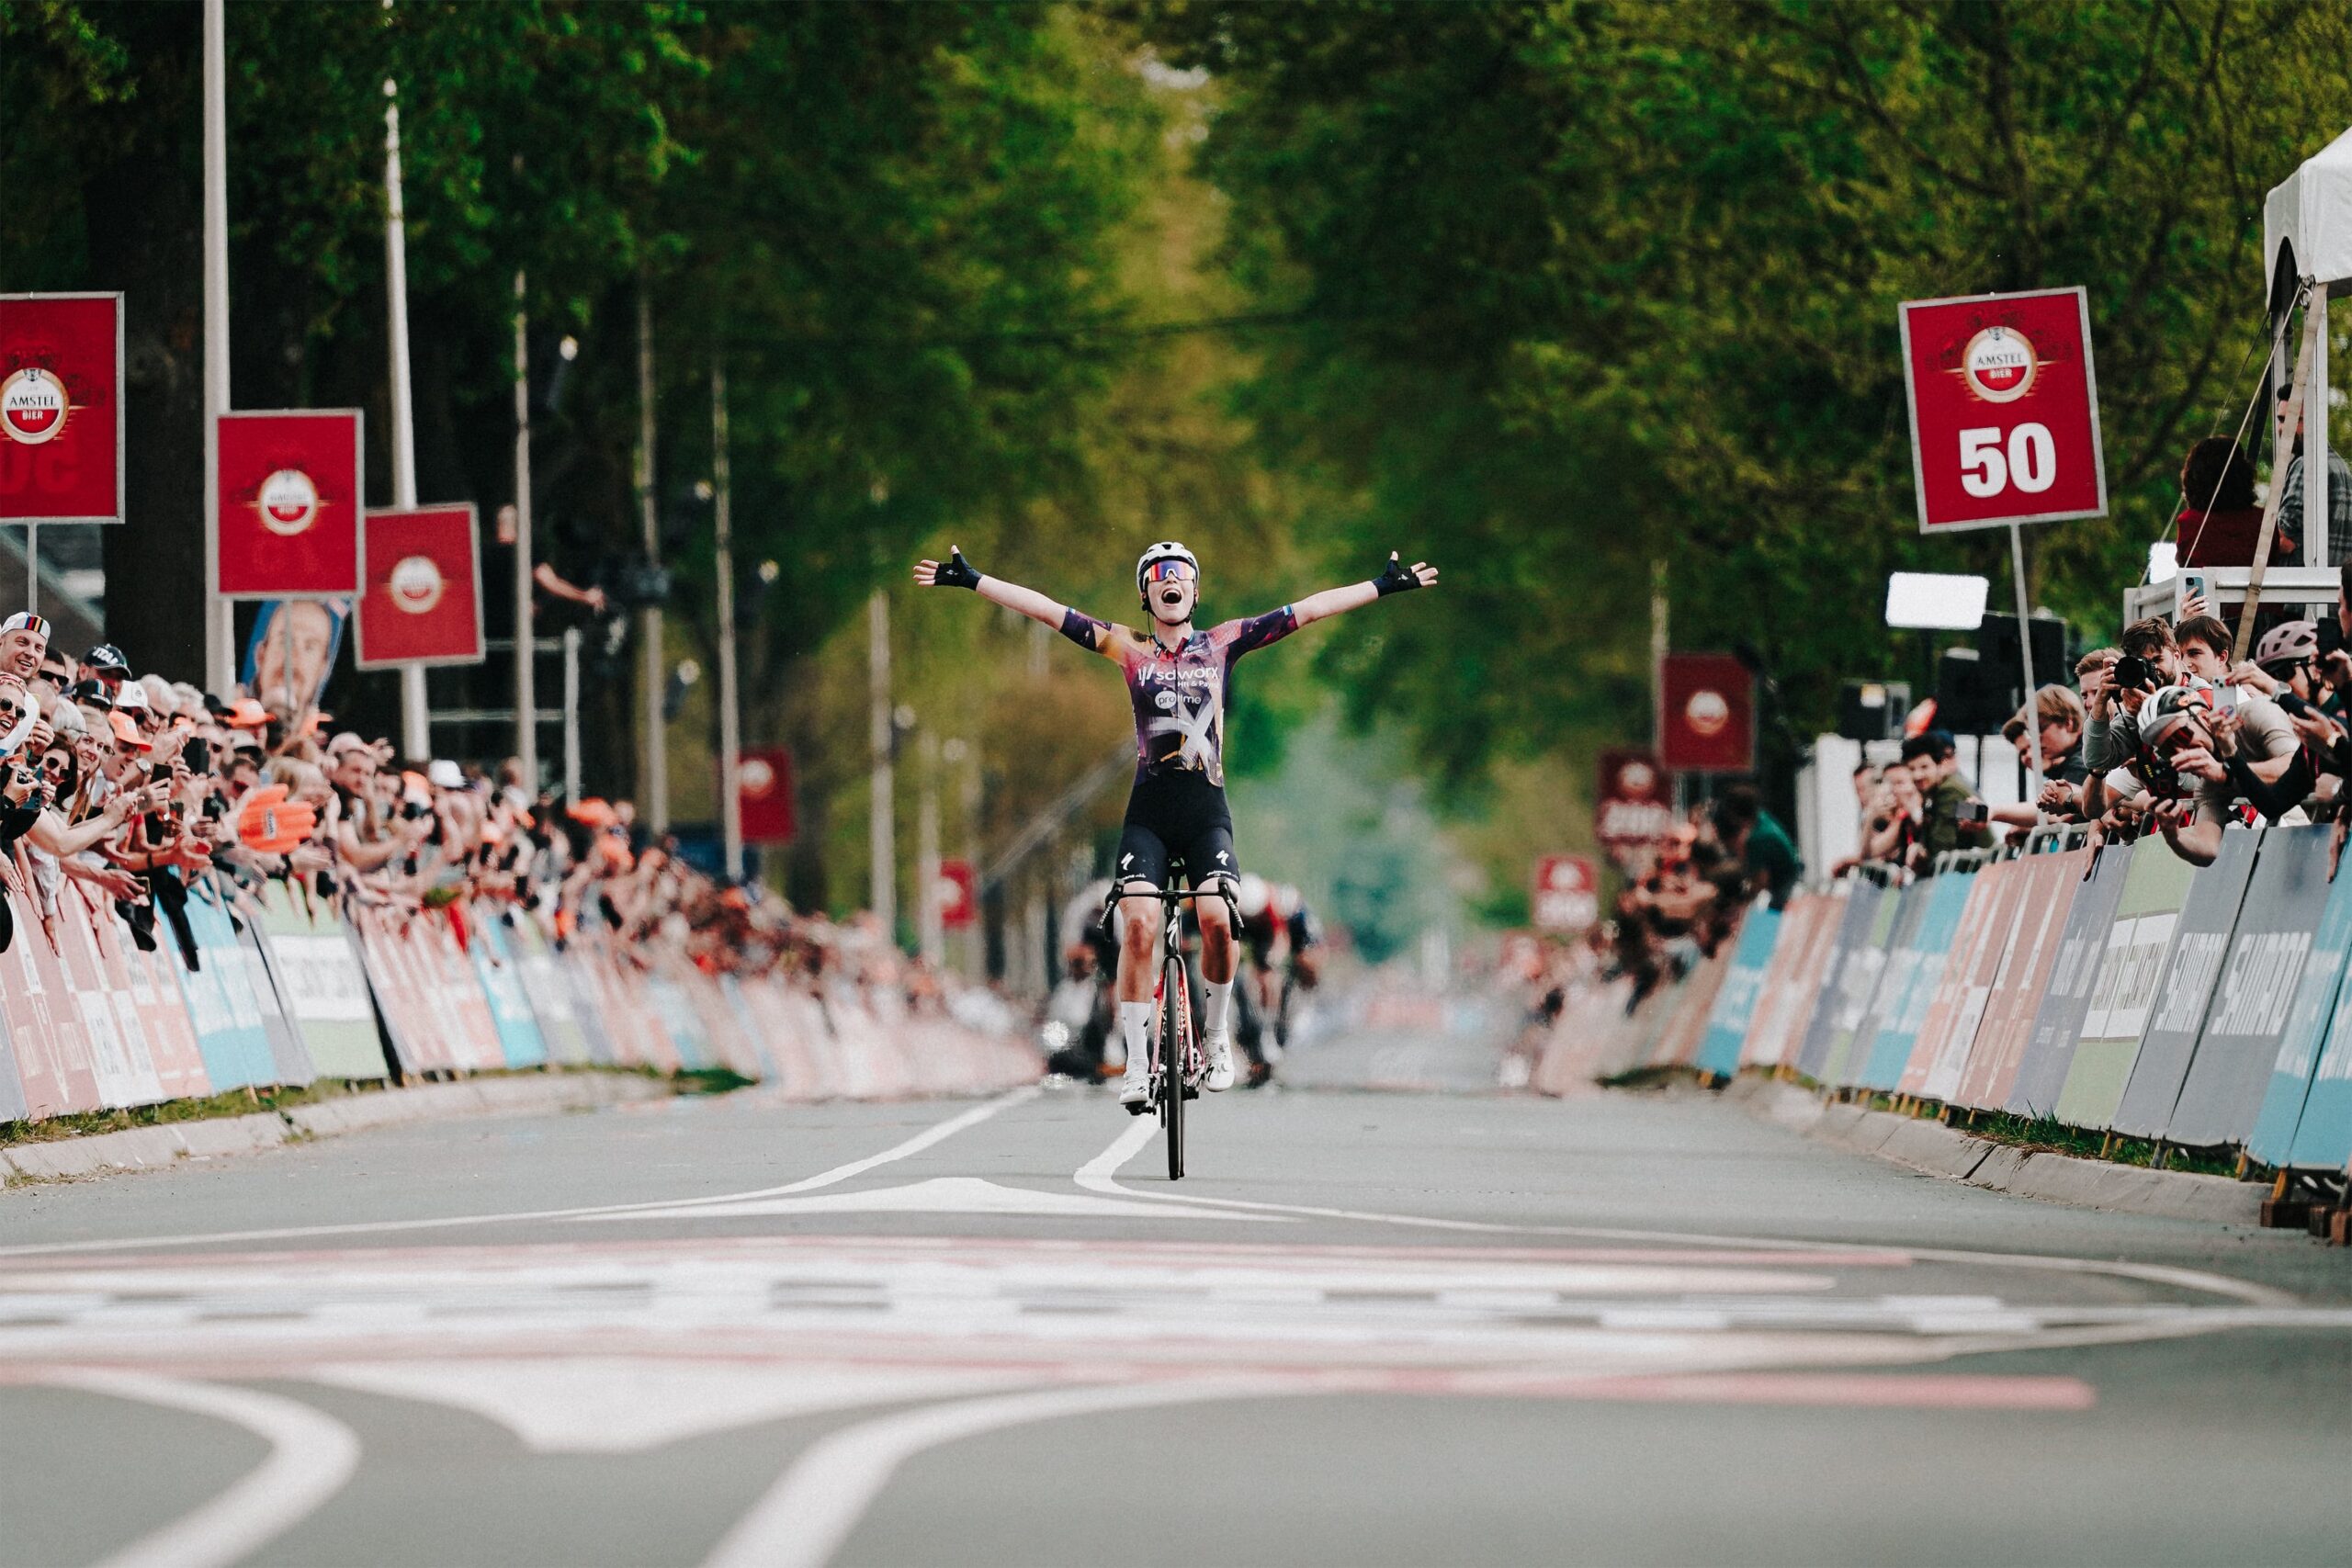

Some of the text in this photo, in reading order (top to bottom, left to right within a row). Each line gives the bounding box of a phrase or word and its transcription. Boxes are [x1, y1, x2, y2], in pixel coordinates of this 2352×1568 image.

[1977, 354, 2024, 366] AMSTEL
[1989, 367, 2013, 379] BIER
[9, 396, 55, 406] AMSTEL
[21, 410, 43, 421] BIER
[1959, 422, 2057, 498] 50
[2211, 931, 2312, 1035] SHIMANO
